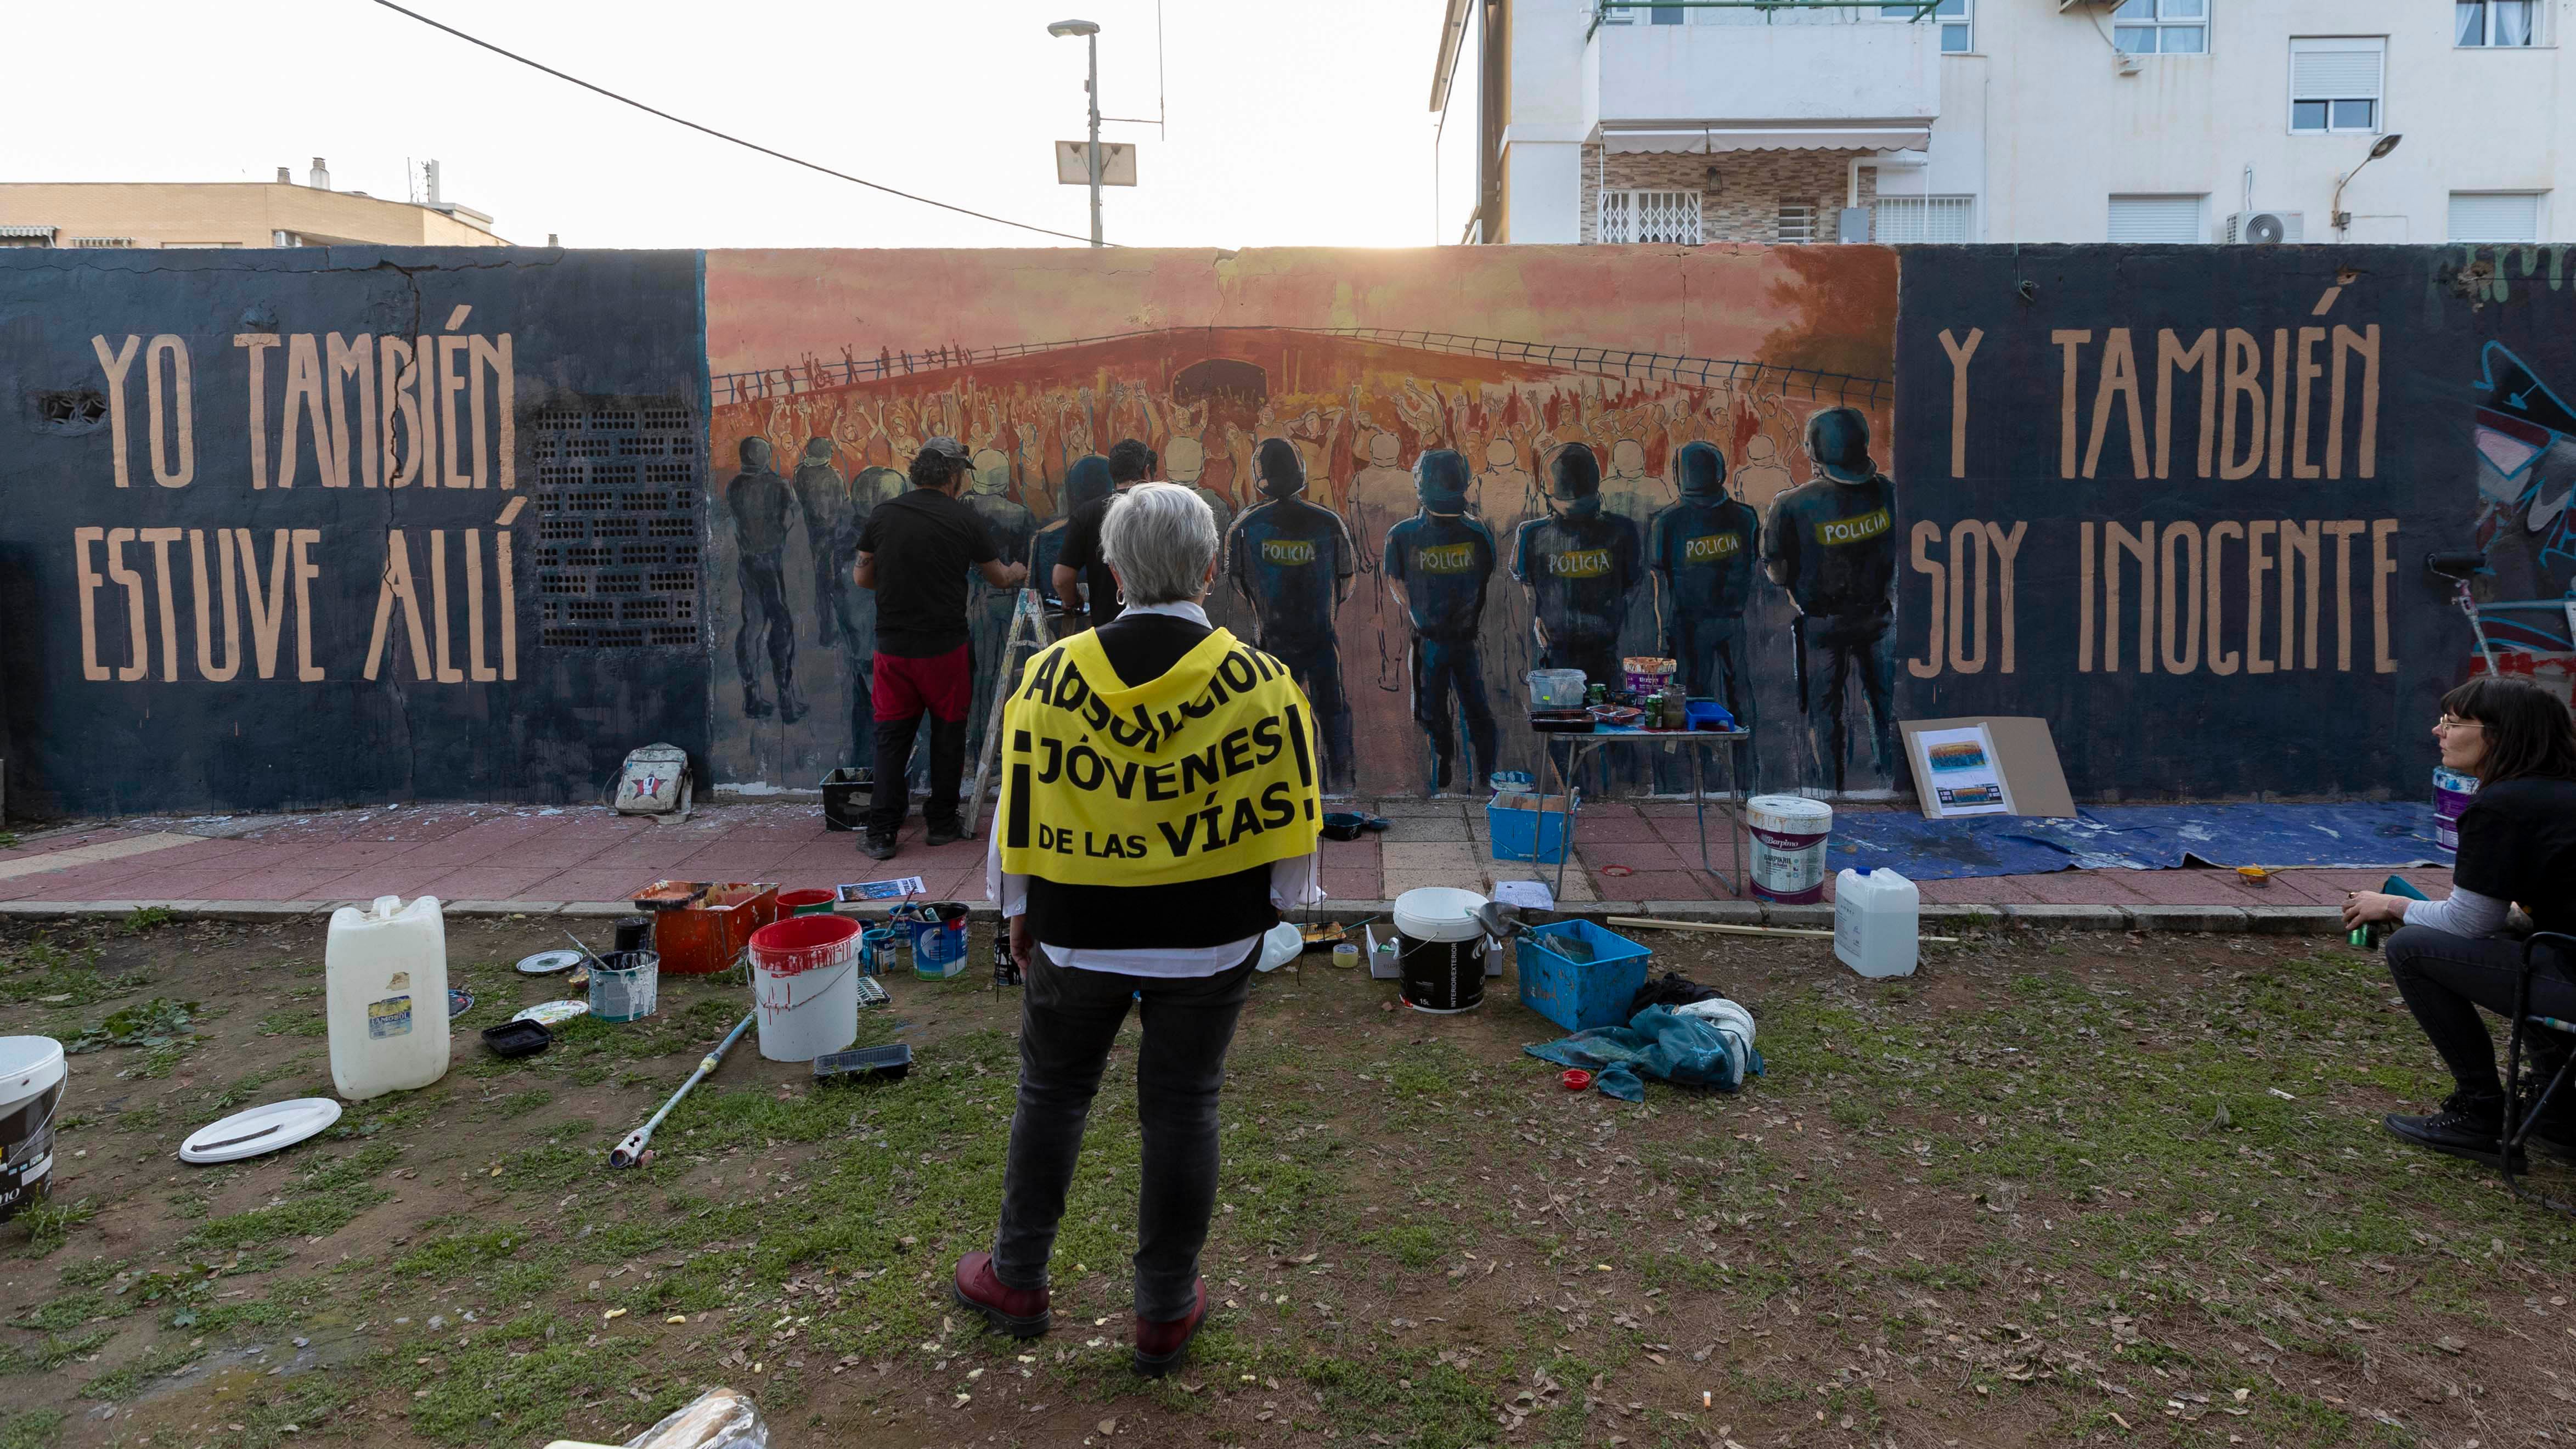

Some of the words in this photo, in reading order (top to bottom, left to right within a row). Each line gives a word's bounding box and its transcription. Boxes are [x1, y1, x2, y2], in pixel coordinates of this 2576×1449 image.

[91, 334, 194, 488] YO
[234, 304, 515, 490] TAMBIÉN
[1938, 327, 1984, 479] Y
[2051, 286, 2380, 480] TAMBIÉN
[1825, 514, 1886, 544] POLICIA
[1420, 549, 1474, 571] POLICIA
[1548, 552, 1610, 574] POLICIA
[1686, 535, 1738, 558] POLICIA
[75, 527, 325, 683] ESTUVE
[363, 496, 528, 683] ALLÍ
[1908, 518, 2027, 679] SOY
[2078, 518, 2399, 676] INOCENTE
[1039, 822, 1073, 855] DE
[1085, 831, 1147, 859] LAS
[1766, 836, 1799, 848] Barpimo
